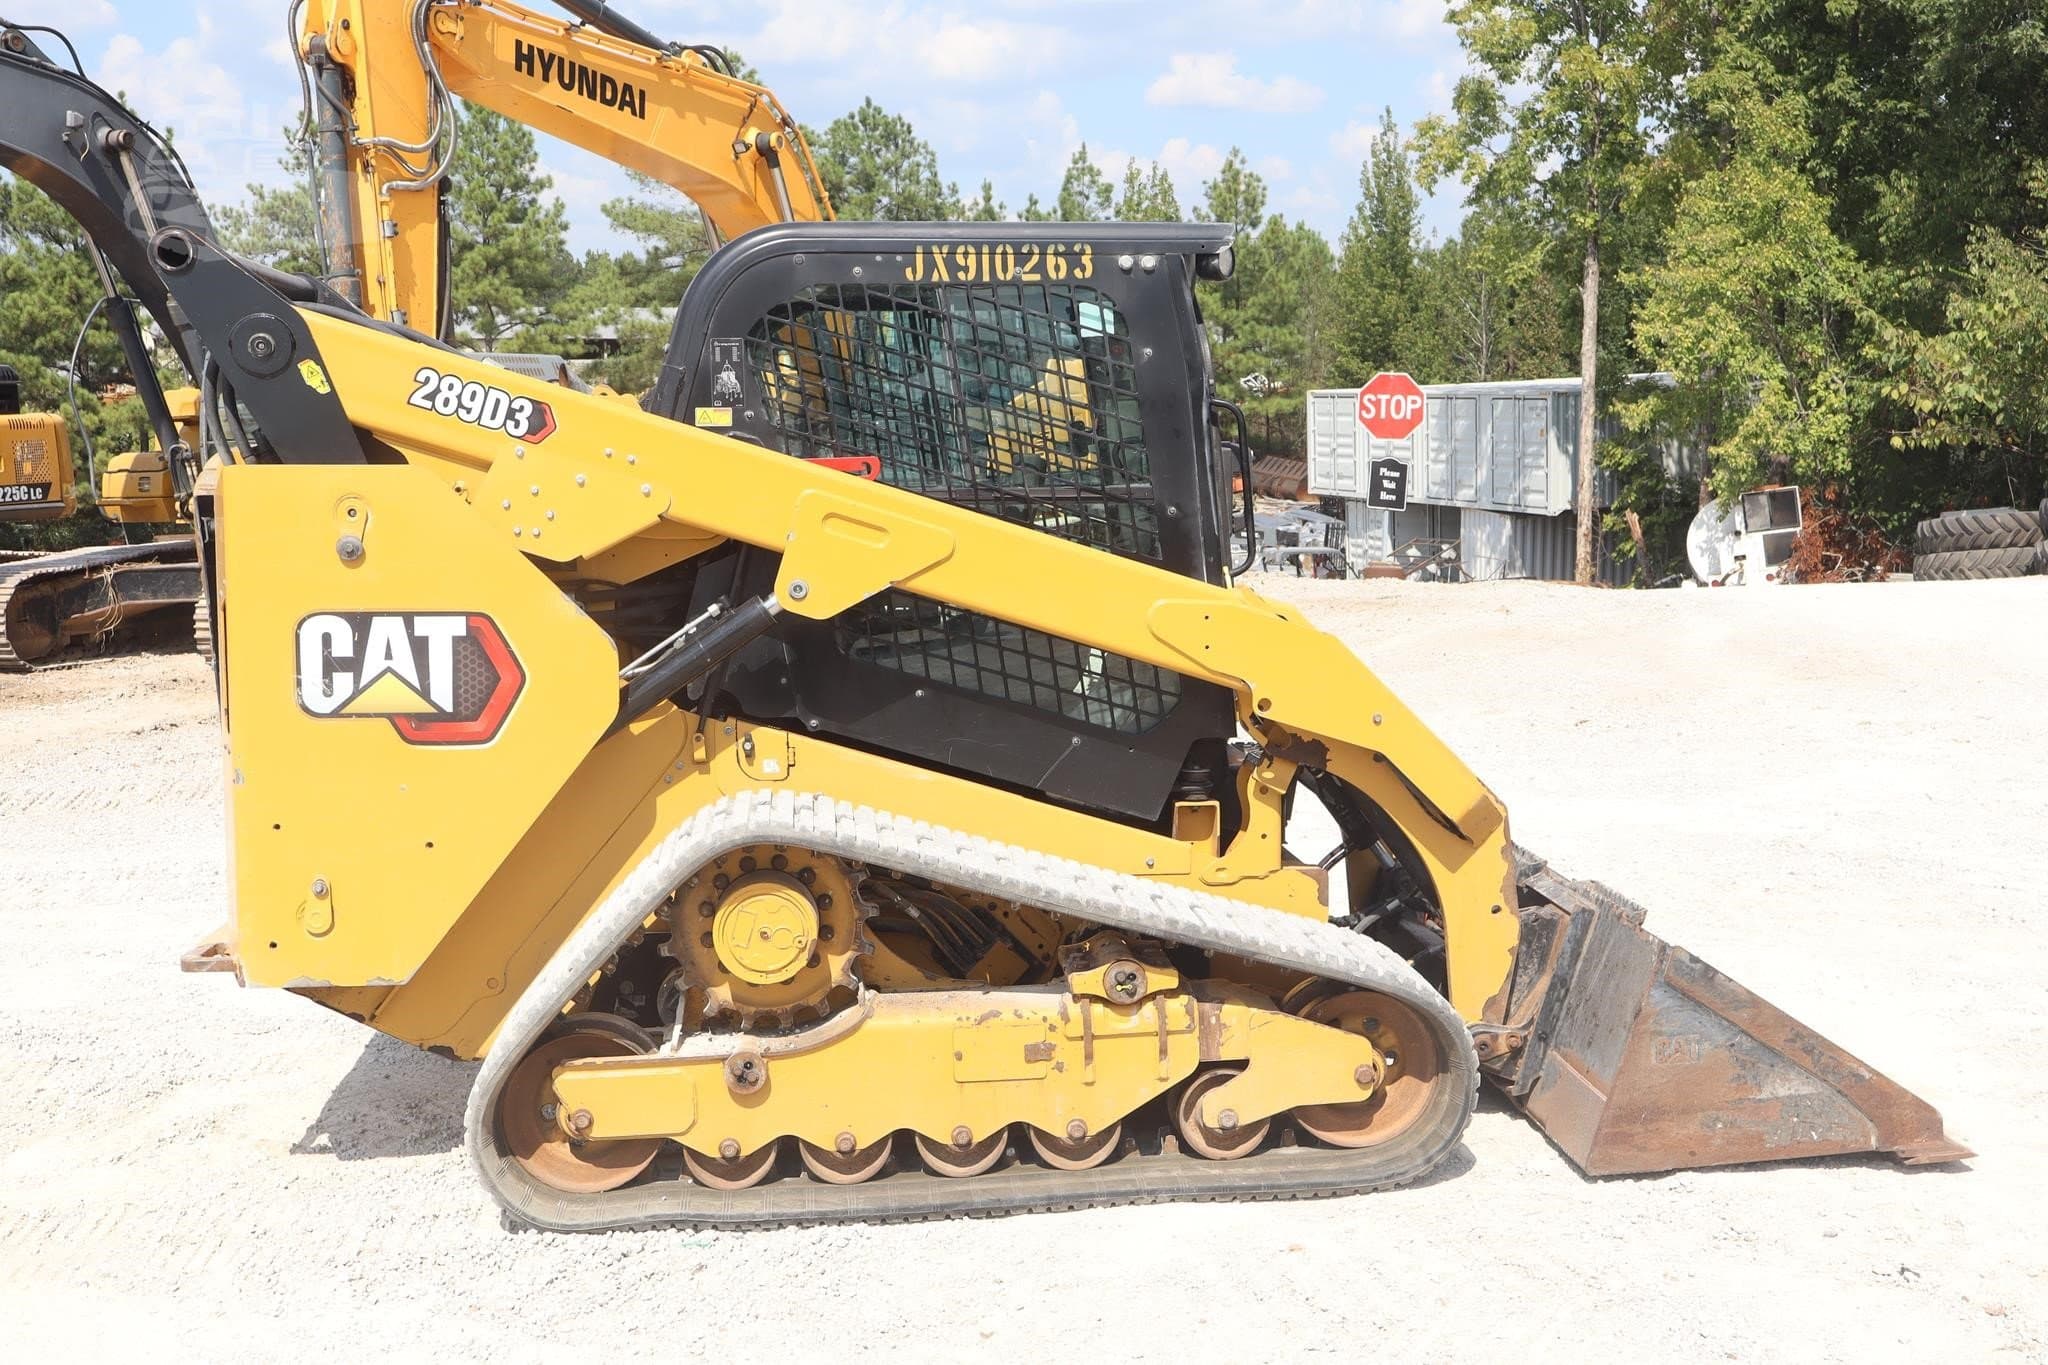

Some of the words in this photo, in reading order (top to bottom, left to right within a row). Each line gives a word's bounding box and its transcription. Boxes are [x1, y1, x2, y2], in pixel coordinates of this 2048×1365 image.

[514, 38, 646, 120] HYUNDAI
[905, 243, 1094, 282] JX910263
[408, 367, 534, 439] 289D3
[1360, 393, 1423, 420] STOP
[1379, 467, 1401, 478] Please
[1382, 479, 1397, 490] Wait
[30, 487, 43, 500] LC
[1380, 491, 1397, 502] Here
[299, 614, 467, 714] CAT
